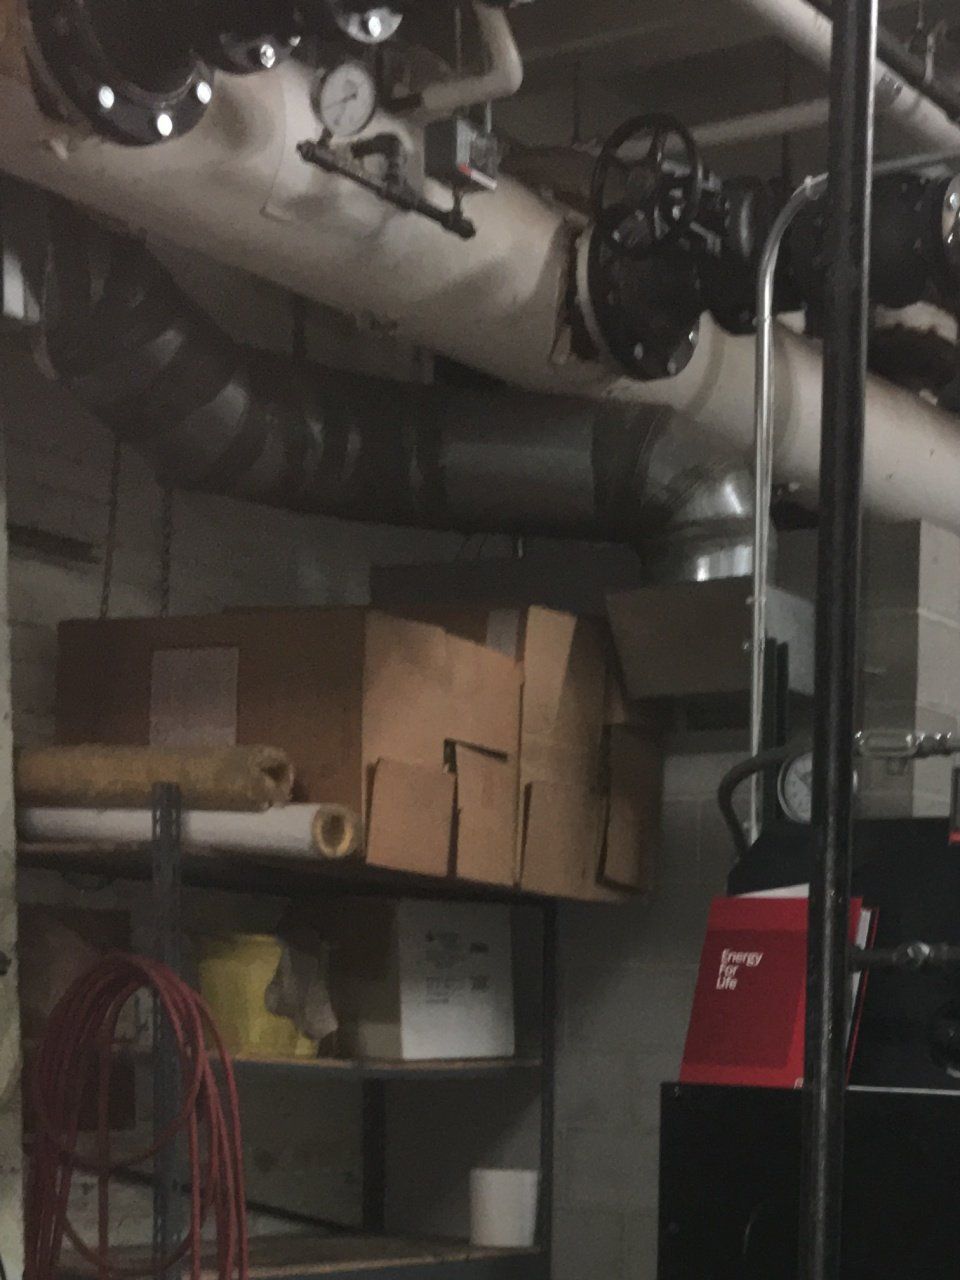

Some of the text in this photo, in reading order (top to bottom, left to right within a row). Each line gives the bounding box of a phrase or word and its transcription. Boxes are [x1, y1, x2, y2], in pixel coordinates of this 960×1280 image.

[721, 948, 763, 967] Energy
[719, 963, 739, 977] For
[716, 976, 738, 990] Life
